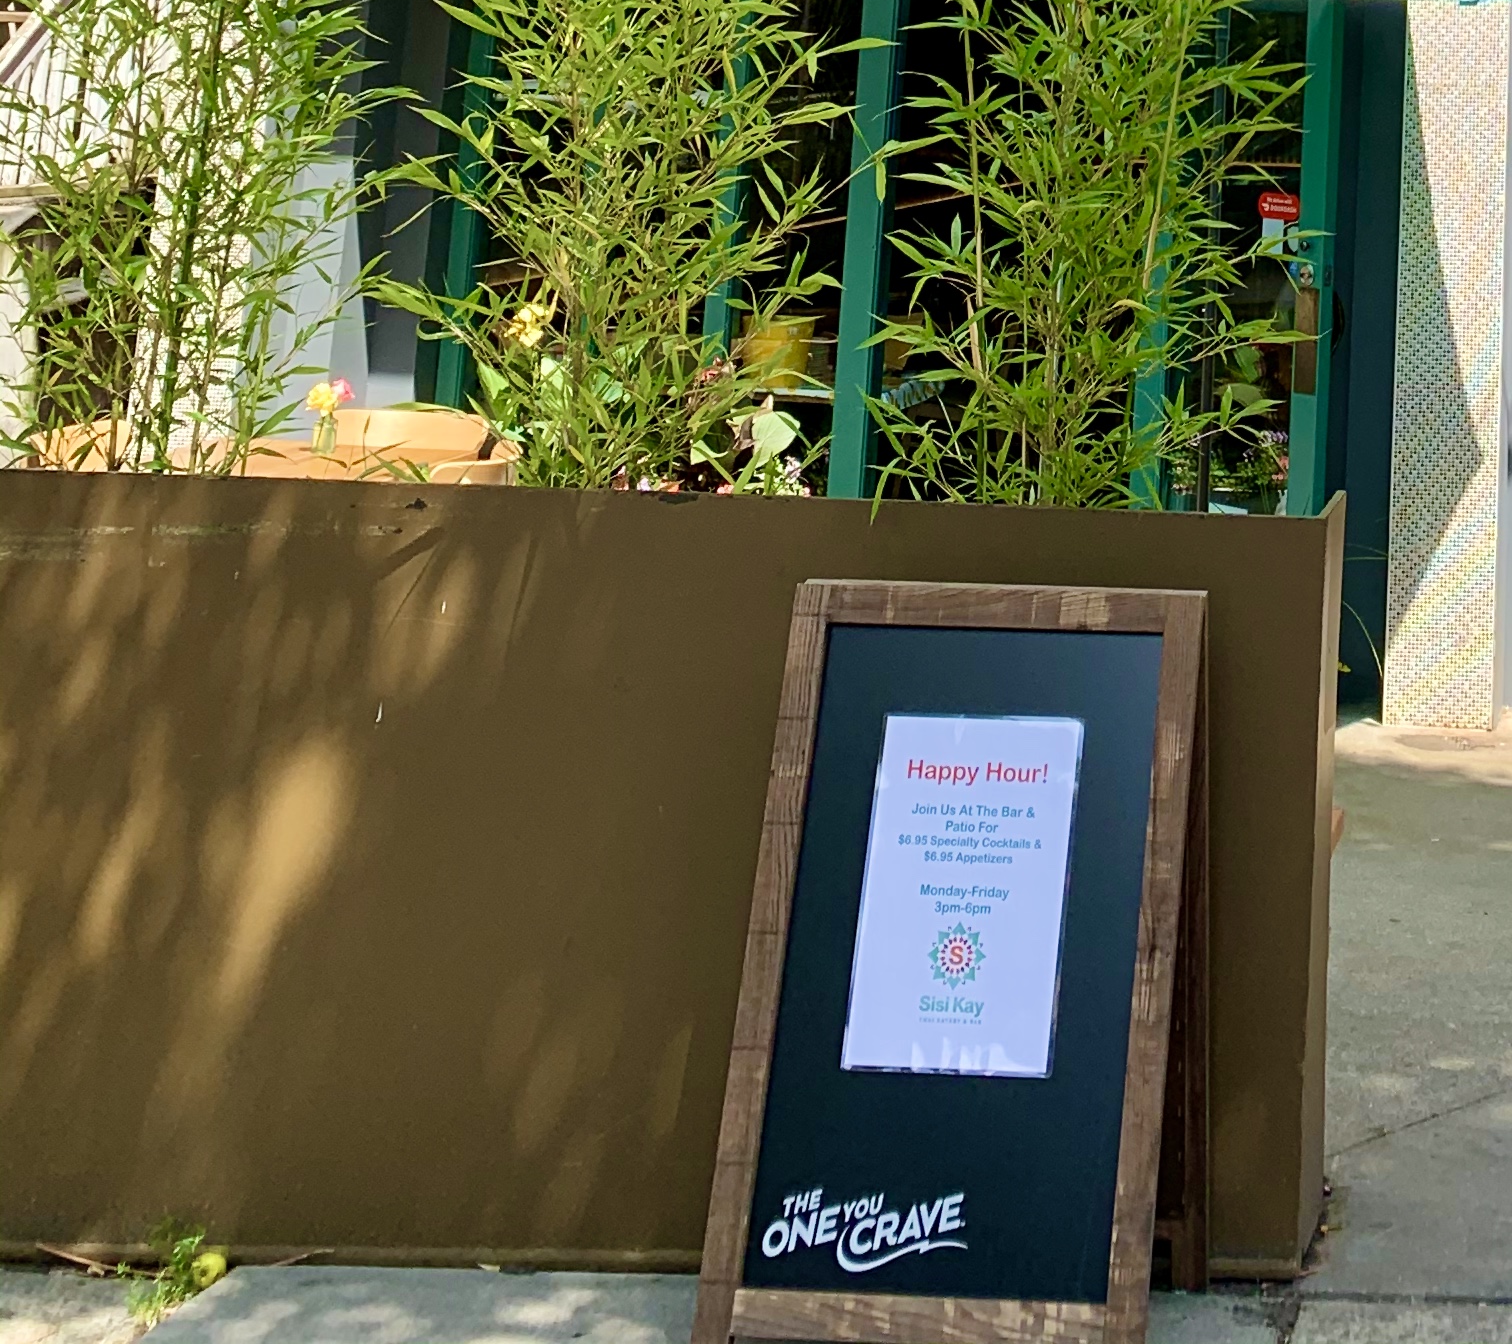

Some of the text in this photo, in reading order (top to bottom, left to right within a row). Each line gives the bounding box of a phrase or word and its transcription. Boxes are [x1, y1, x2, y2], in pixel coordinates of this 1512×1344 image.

[907, 759, 1048, 786] Happy Hour!
[911, 803, 1035, 818] Join Us At The Bar &
[945, 820, 998, 833] Patio For
[898, 834, 1042, 849] $6.95 Specialty Cocktails &
[924, 850, 1013, 864] $6.95 Appetizers
[920, 884, 1010, 901] Monday-Friday
[934, 901, 991, 916] 3pm-6pm
[949, 945, 964, 965] S
[919, 995, 984, 1017] Sisi Kay
[783, 1188, 823, 1218] THE
[843, 1193, 884, 1223] YOU
[762, 1205, 841, 1258] ONE
